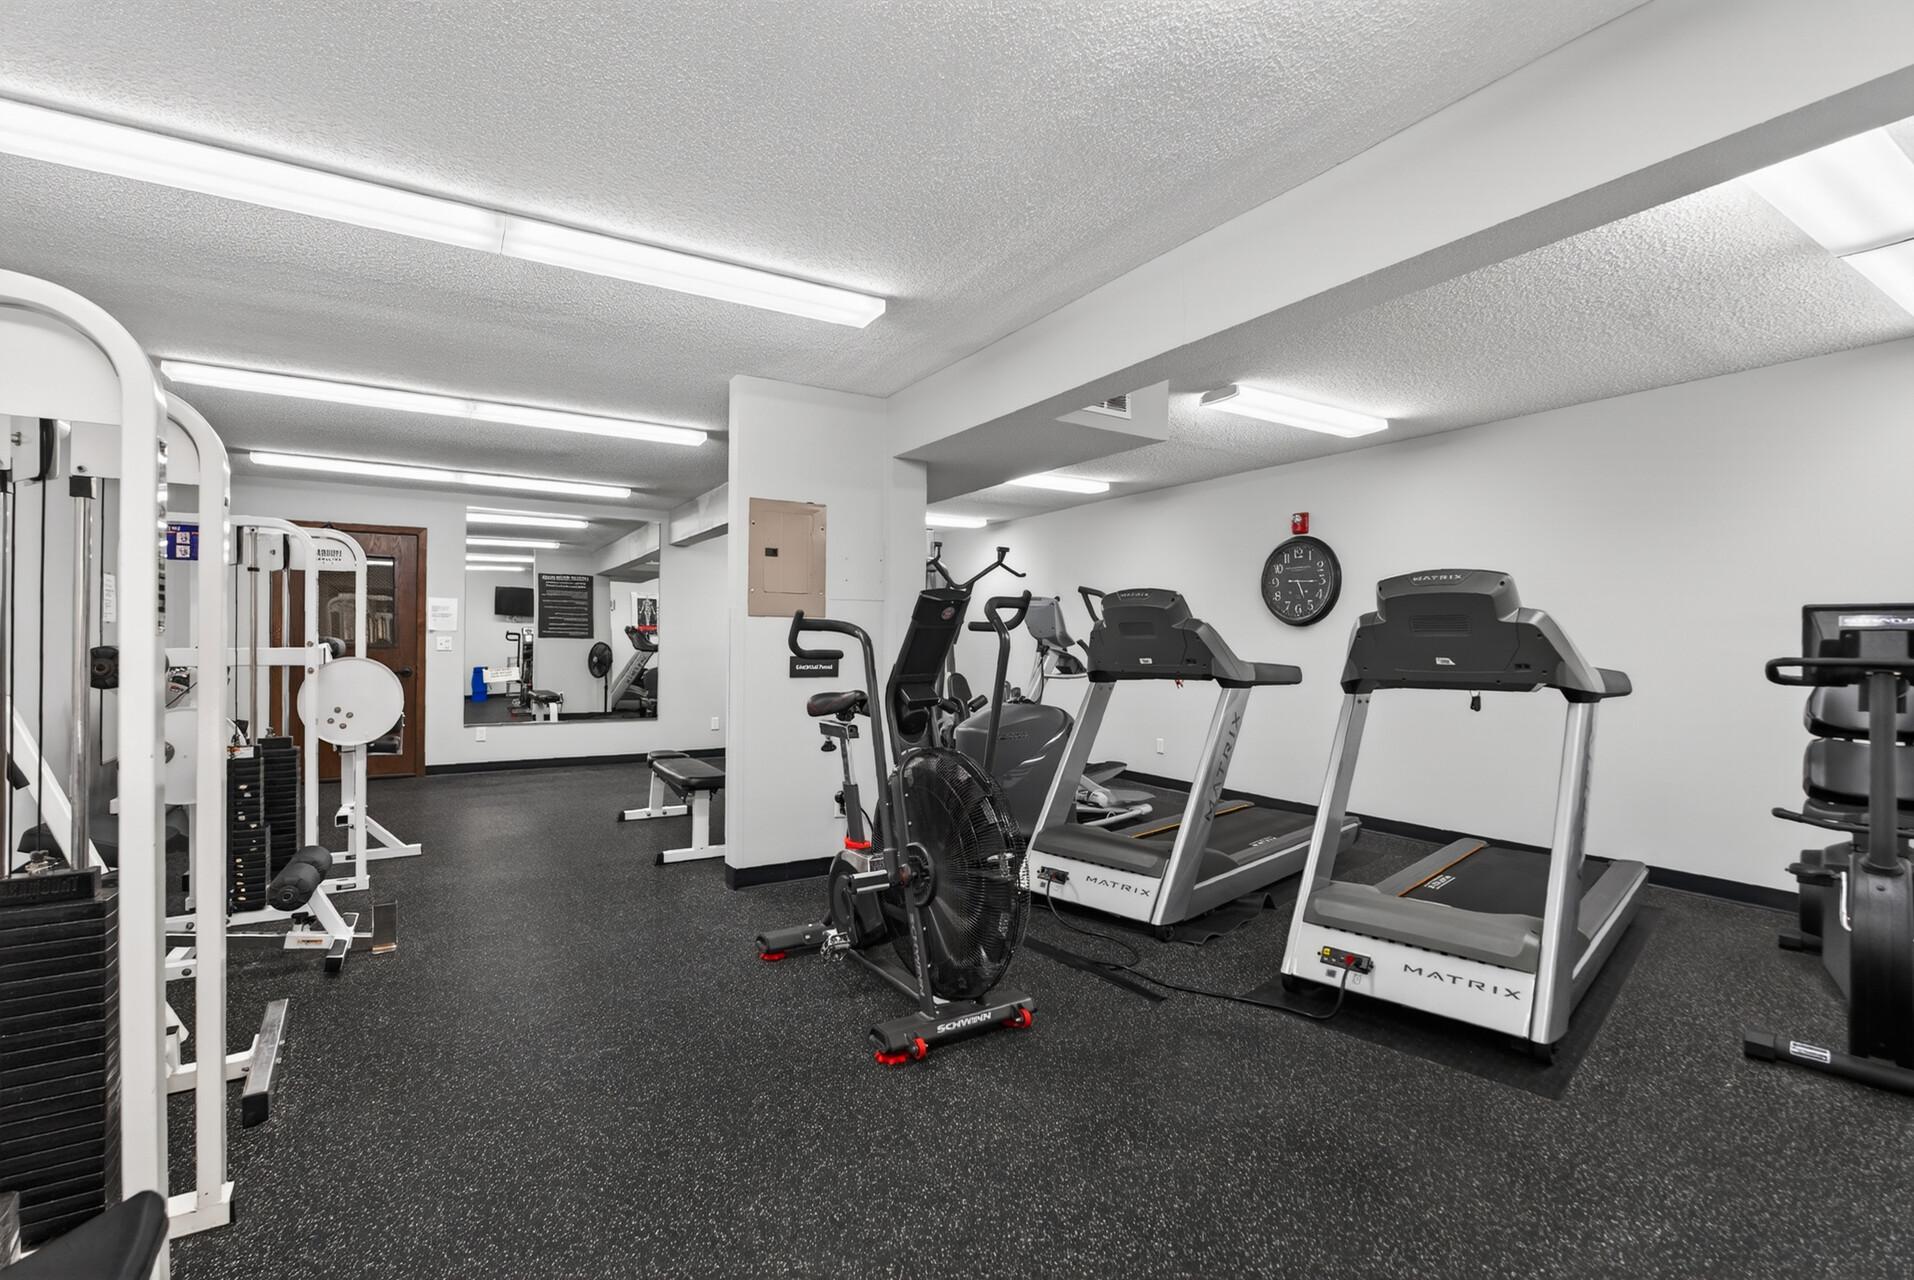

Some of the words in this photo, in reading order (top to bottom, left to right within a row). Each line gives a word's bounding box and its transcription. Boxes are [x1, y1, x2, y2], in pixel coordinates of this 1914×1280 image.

[1283, 552, 1290, 564] 11
[1294, 547, 1303, 559] 12
[1273, 563, 1284, 575] 10
[1271, 577, 1280, 588] 9
[1412, 574, 1462, 582] MATRIX
[1272, 590, 1282, 602] 8
[1282, 600, 1291, 614] 7
[1294, 603, 1302, 617] 6
[1307, 599, 1314, 611] 5
[1204, 711, 1241, 822] MATRIX
[1086, 875, 1151, 897] MATRIX
[1403, 964, 1521, 1001] MATRIX
[936, 1011, 992, 1034] SCHWINN
